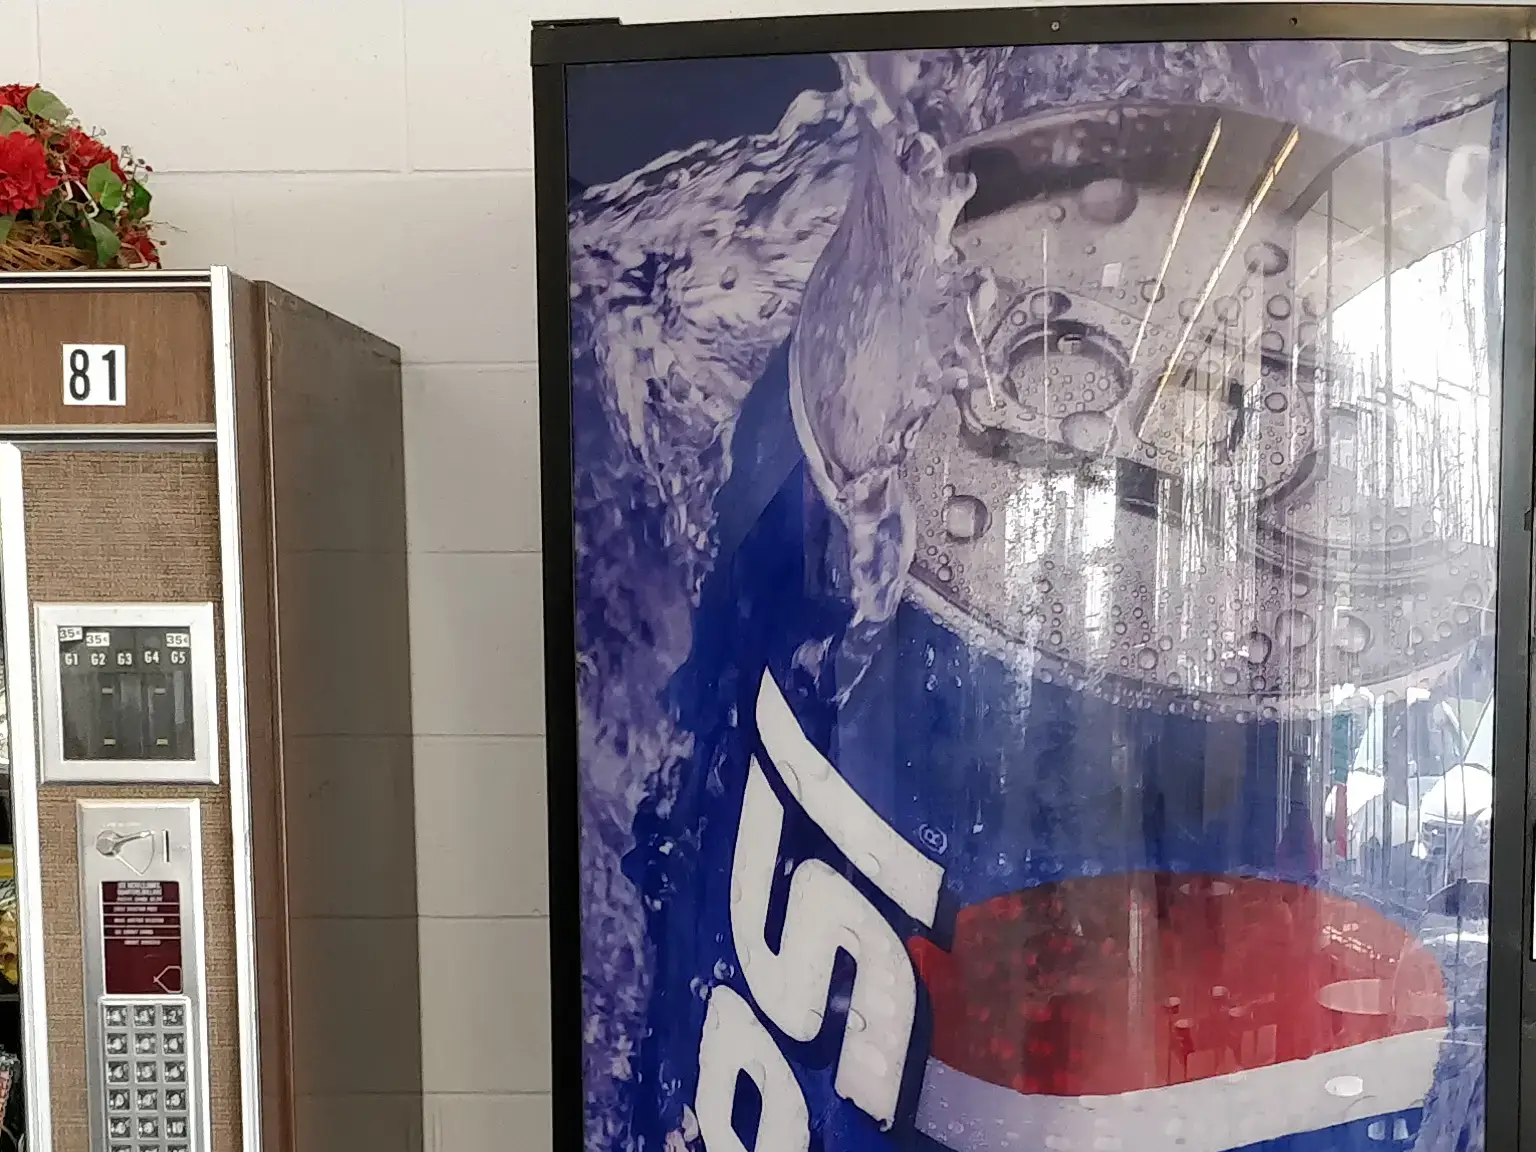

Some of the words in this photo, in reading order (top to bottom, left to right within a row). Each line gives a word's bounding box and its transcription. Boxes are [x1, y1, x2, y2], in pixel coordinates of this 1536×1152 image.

[69, 348, 116, 401] 81
[64, 653, 78, 666] G1
[91, 652, 106, 666] G2
[117, 652, 133, 665] G3
[144, 650, 159, 664] G4
[170, 650, 186, 664] G5
